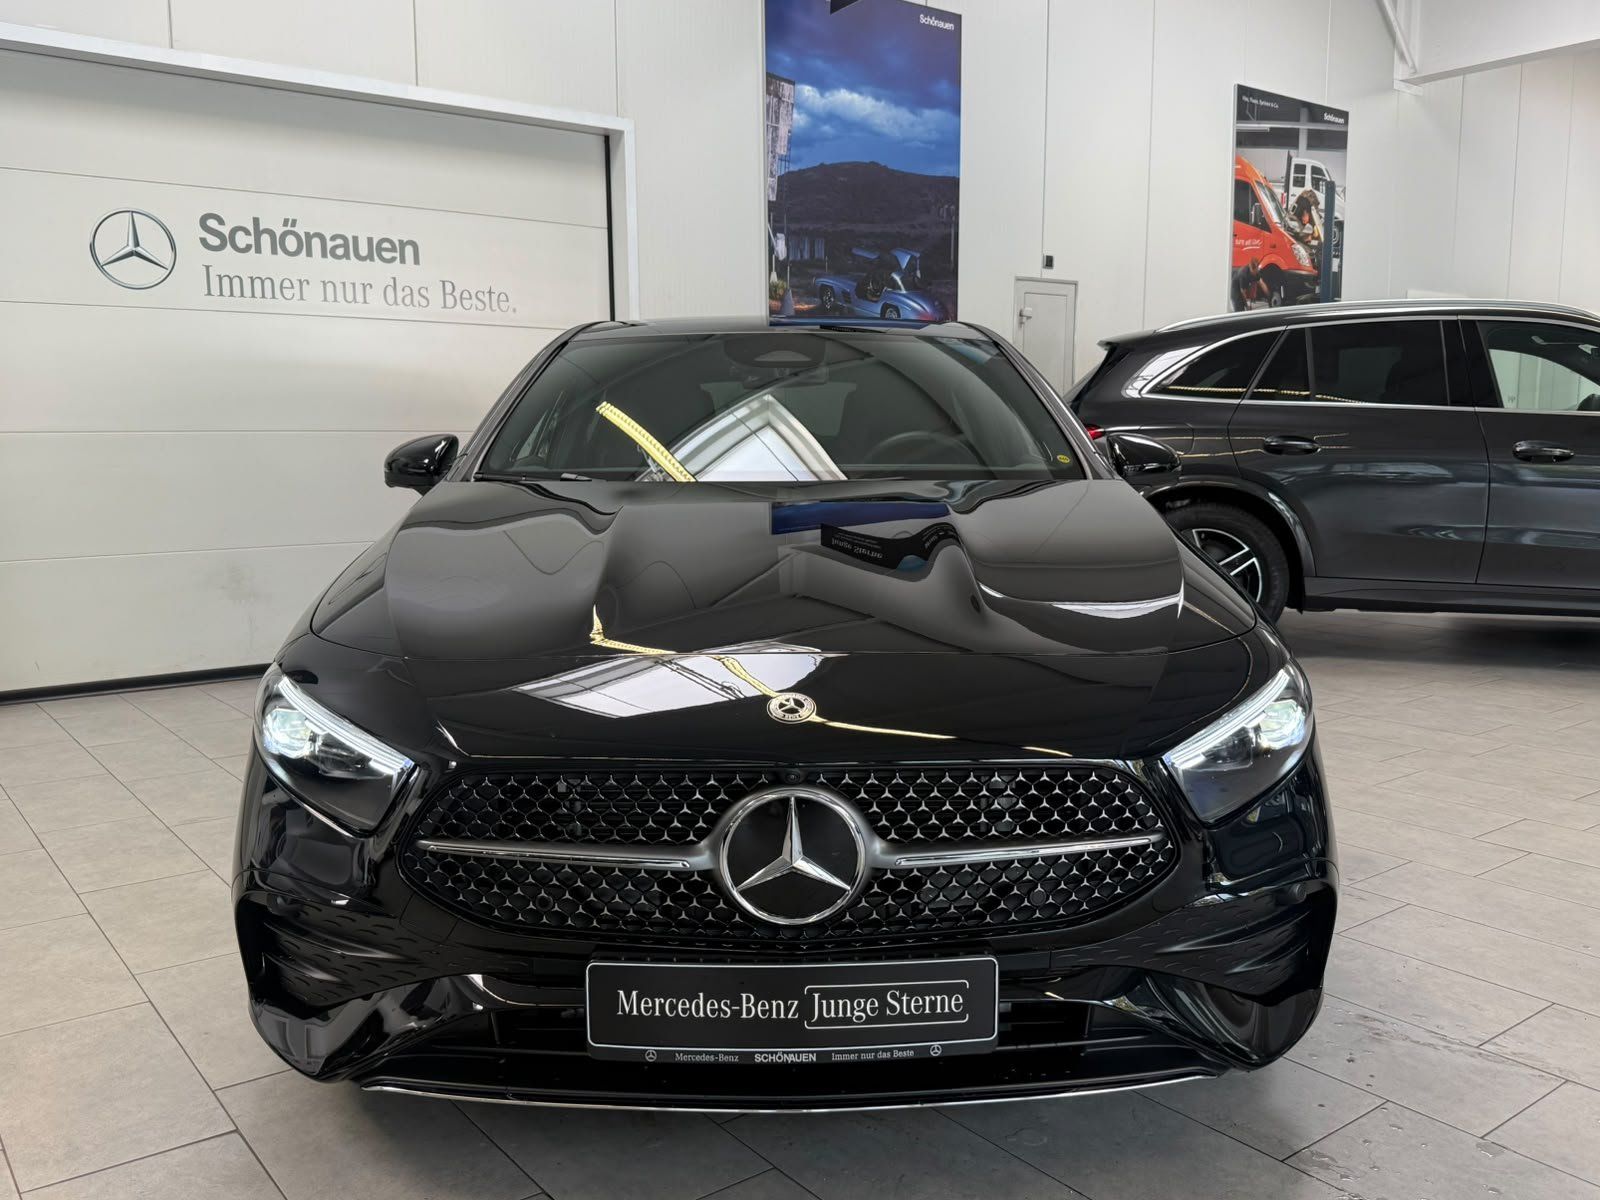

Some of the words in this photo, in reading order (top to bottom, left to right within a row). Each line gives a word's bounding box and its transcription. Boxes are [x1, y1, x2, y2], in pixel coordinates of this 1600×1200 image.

[919, 14, 954, 30] Schönauen
[199, 212, 420, 266] Schönauen
[202, 264, 310, 302] Immer
[320, 276, 373, 305] nur
[383, 276, 430, 308] das
[439, 279, 517, 313] Beste.
[616, 990, 799, 1019] Mercedes-Benz
[810, 993, 879, 1023] Junge
[886, 990, 964, 1016] Sterne
[674, 1052, 739, 1063] Mercedes-Benz
[754, 1051, 817, 1063] SCHÖNAUEN
[831, 1052, 858, 1061] Immer
[860, 1051, 875, 1060] nur
[877, 1050, 891, 1059] das
[893, 1049, 915, 1058] Beste
